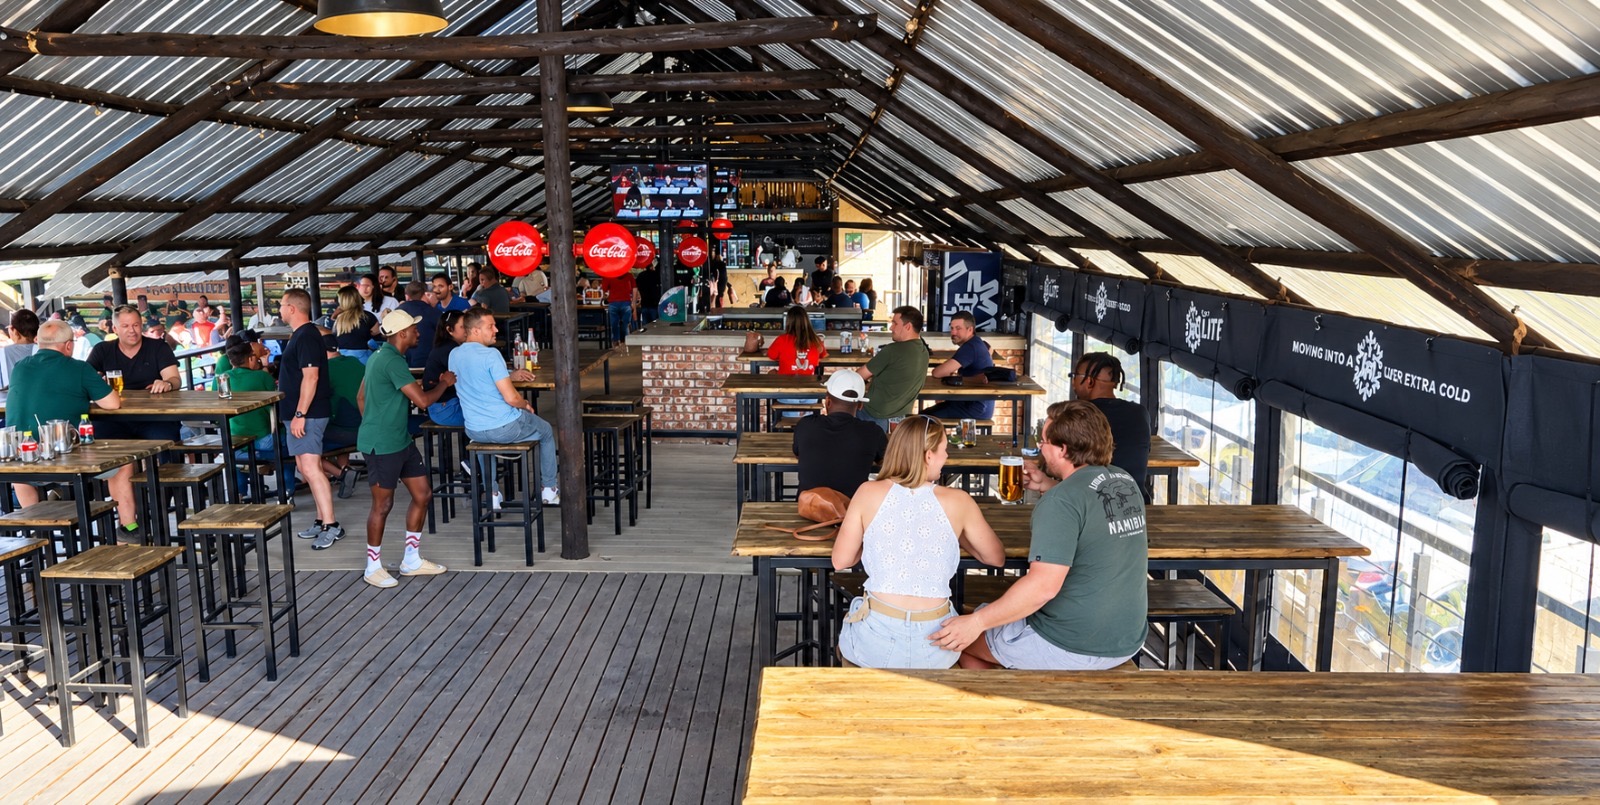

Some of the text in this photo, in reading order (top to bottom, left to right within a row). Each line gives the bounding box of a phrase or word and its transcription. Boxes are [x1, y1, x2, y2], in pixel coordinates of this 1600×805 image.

[1201, 317, 1224, 341] LITE
[1292, 340, 1323, 360] MOVING
[1324, 348, 1345, 365] INTO
[1345, 354, 1354, 368] A
[1403, 372, 1436, 395] EXTRA
[1439, 382, 1471, 403] COLD
[1108, 515, 1145, 535] NAMIBIA
